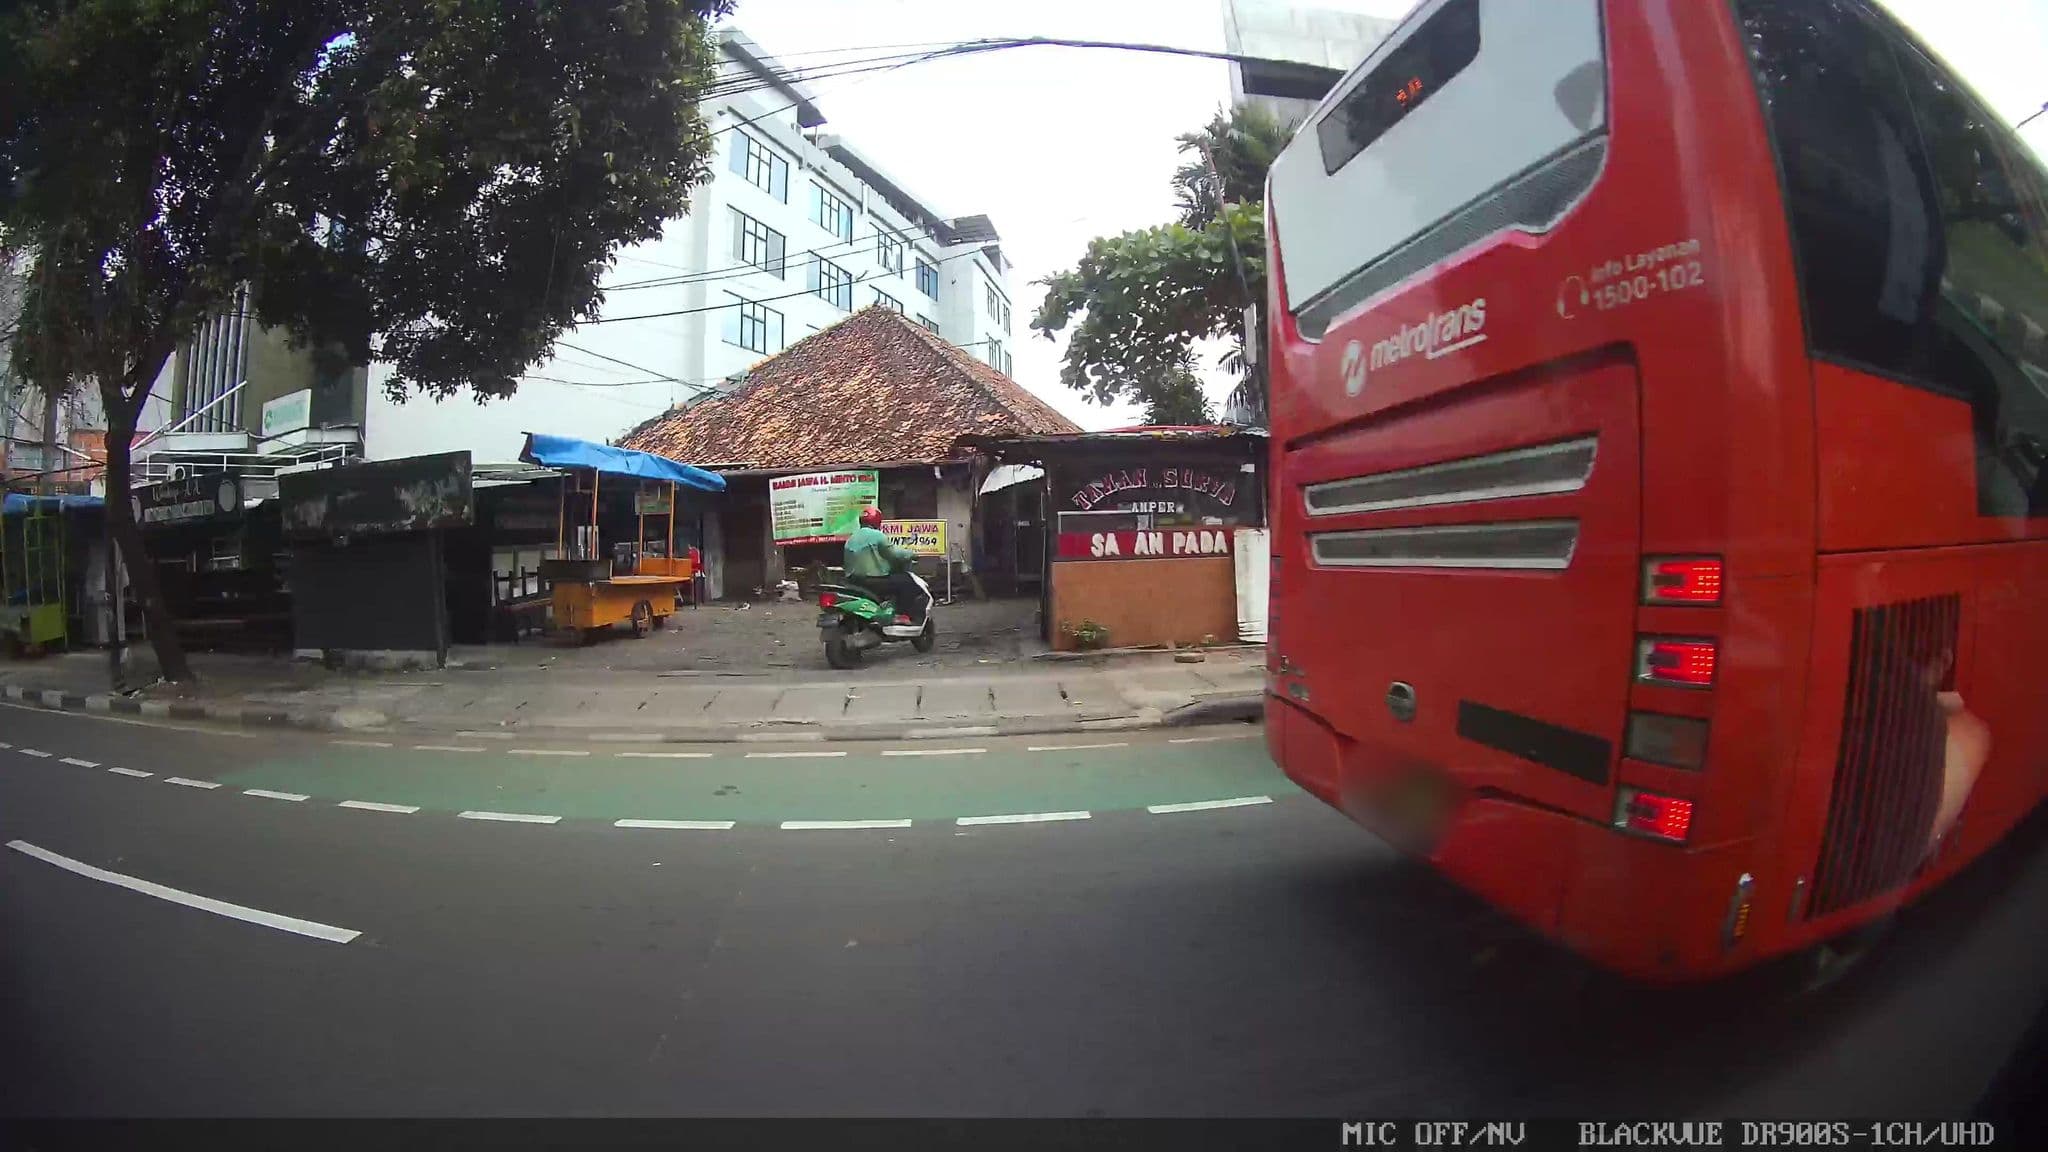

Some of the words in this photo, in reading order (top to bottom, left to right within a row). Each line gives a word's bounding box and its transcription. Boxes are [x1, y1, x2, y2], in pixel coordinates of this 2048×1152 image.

[1626, 239, 1701, 271] Layanan
[1594, 260, 1705, 311] 1500-102
[1370, 298, 1488, 371] metrotrans
[907, 524, 939, 533] JAWA
